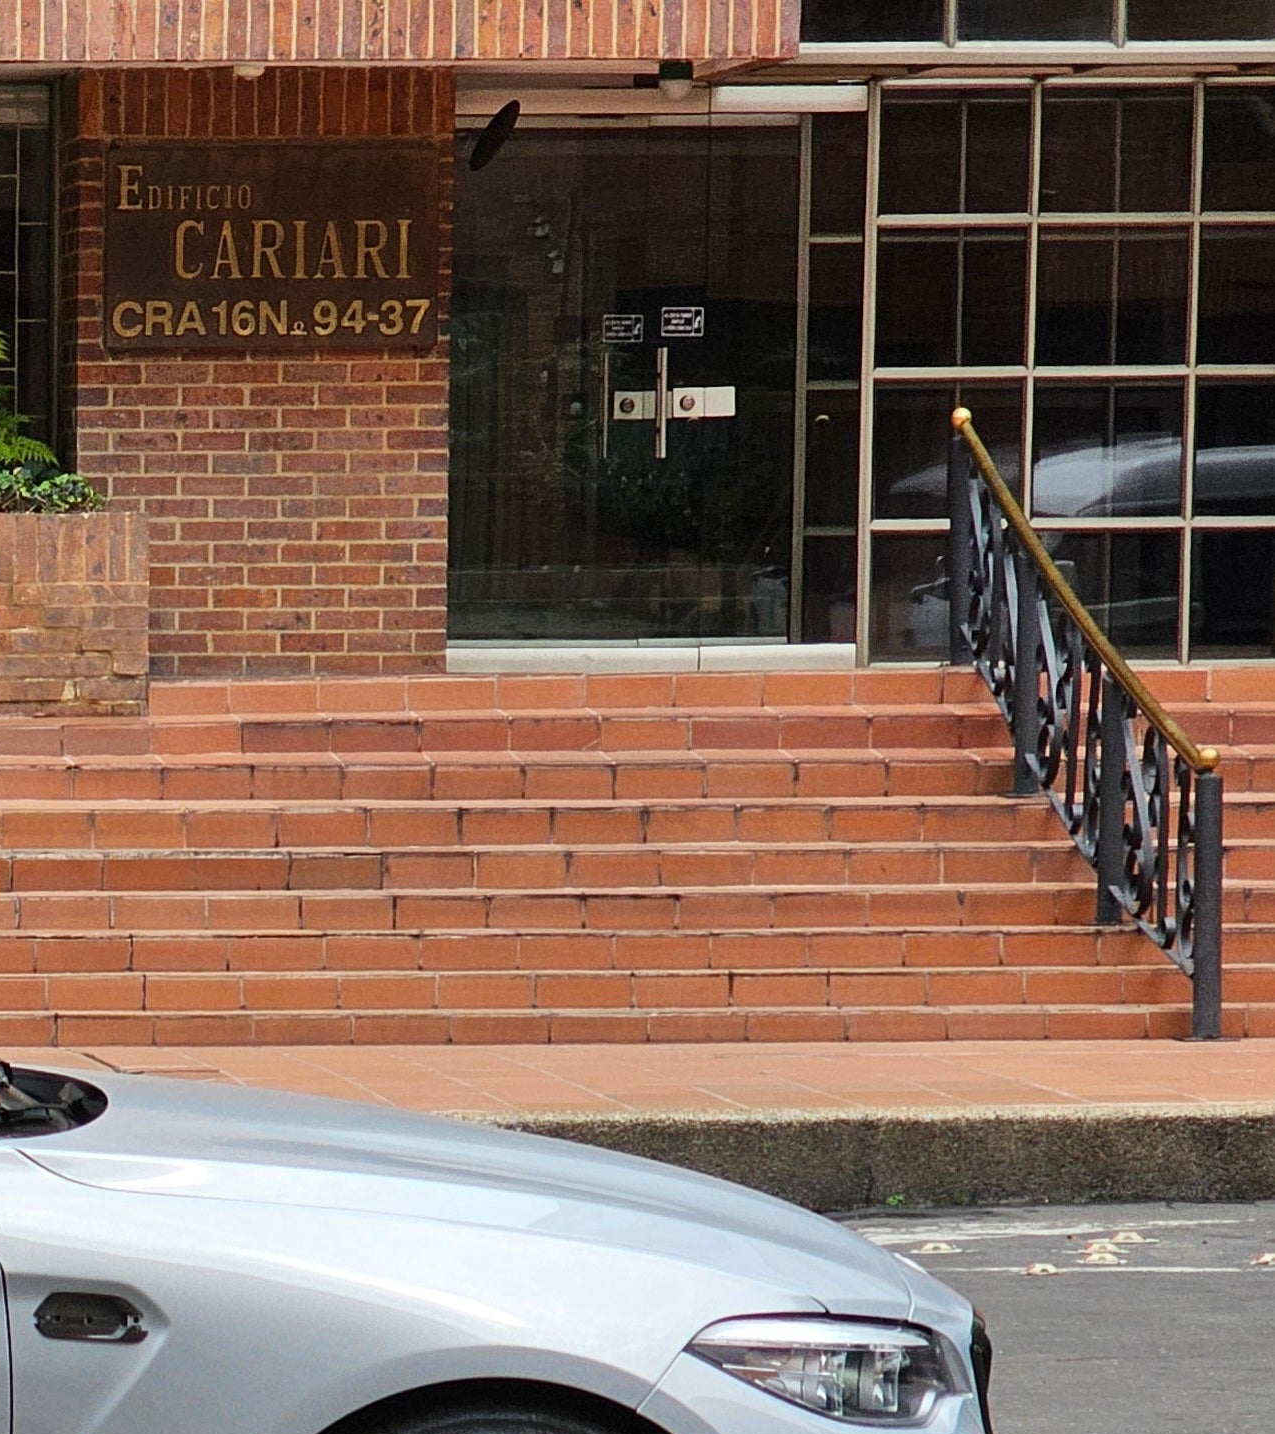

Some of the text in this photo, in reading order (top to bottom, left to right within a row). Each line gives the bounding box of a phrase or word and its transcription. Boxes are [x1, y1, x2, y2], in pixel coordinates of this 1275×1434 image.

[174, 218, 413, 280] CARIARI
[111, 300, 208, 337] CRA
[312, 299, 432, 337] 94-37
